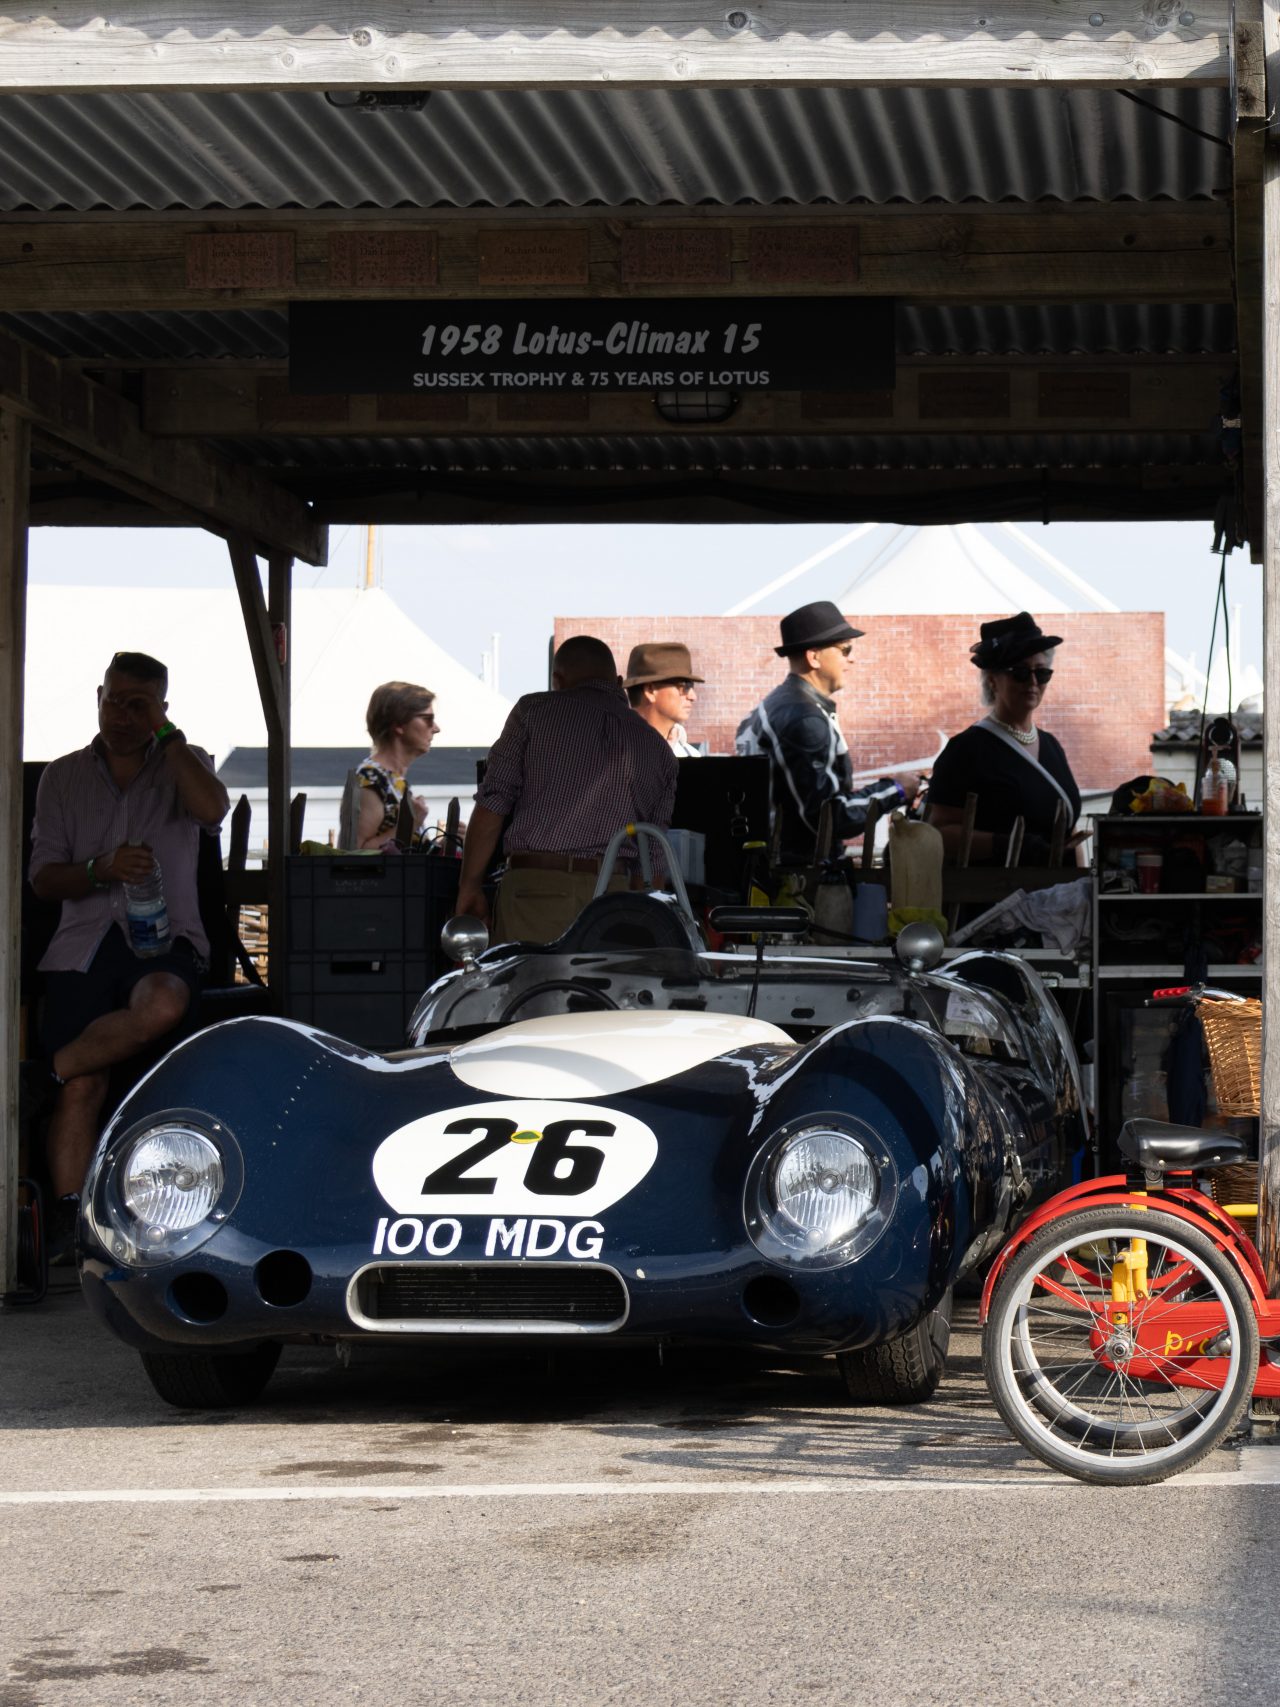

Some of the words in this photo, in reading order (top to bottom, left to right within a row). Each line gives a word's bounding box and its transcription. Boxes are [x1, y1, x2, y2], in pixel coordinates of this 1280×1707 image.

[422, 324, 503, 356] 1958
[512, 320, 710, 355] Lotus-Climax
[723, 323, 762, 354] 15
[413, 372, 485, 387] SUSSEX
[490, 372, 567, 387] TROPHY
[571, 372, 585, 386] &
[590, 372, 609, 386] 75
[614, 371, 675, 386] YEARS
[679, 371, 704, 386] OF
[709, 370, 770, 385] LOTUS
[421, 1117, 617, 1196] 26
[485, 1217, 605, 1260] MDG
